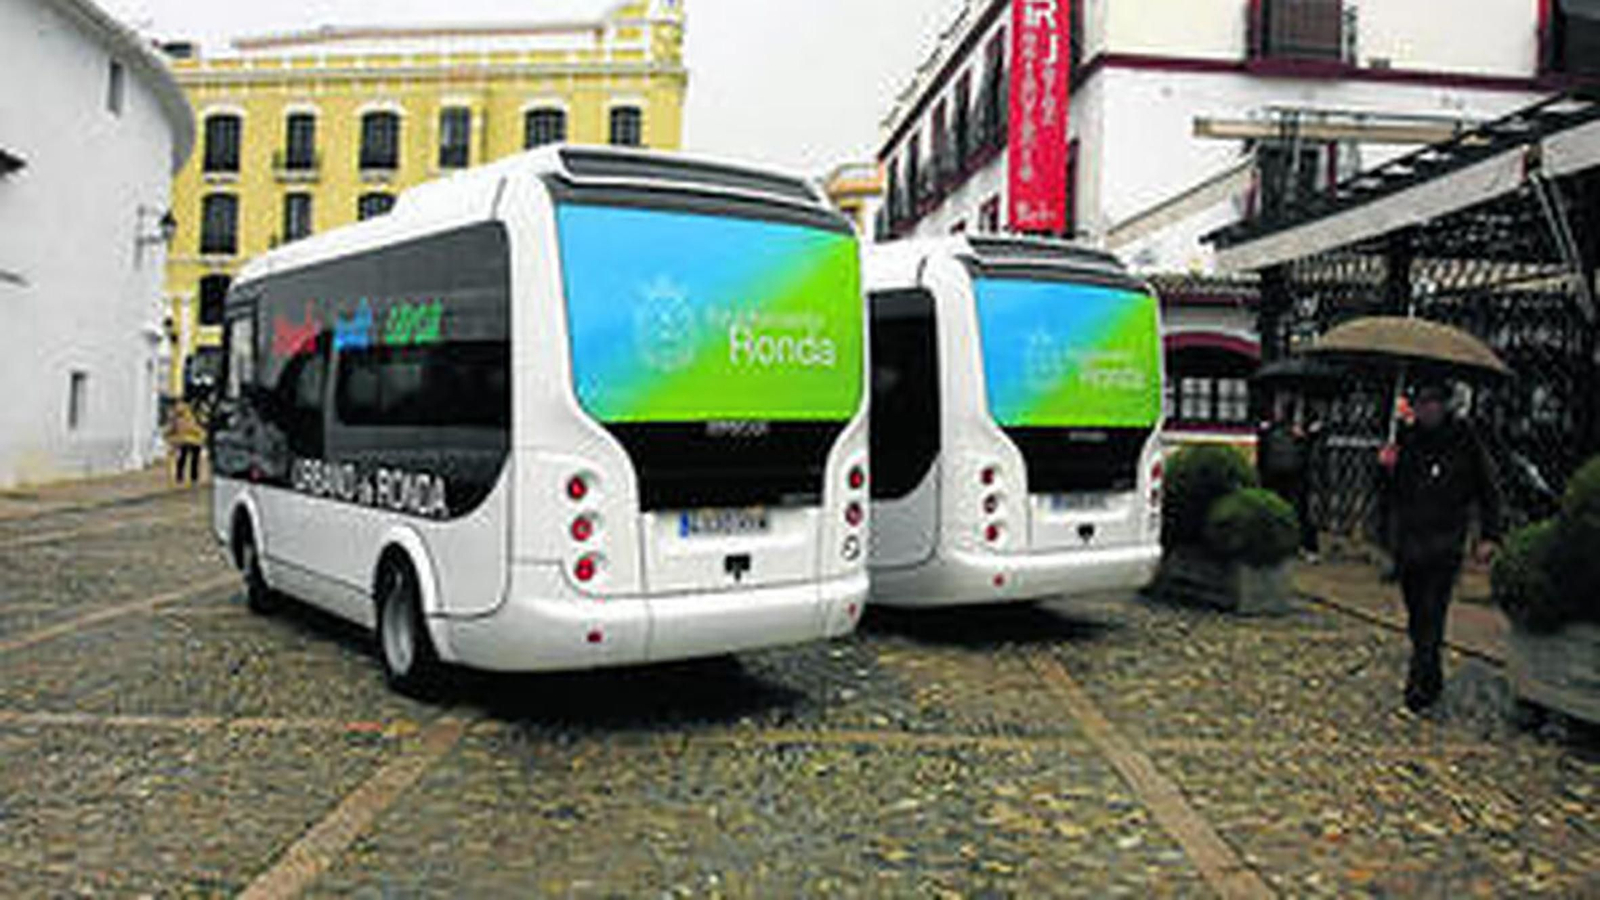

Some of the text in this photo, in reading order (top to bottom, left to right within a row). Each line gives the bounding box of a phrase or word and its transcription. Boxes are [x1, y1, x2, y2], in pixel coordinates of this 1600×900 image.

[729, 323, 837, 366] Ronda
[291, 457, 355, 499] URBANO
[376, 467, 450, 519] RONDA
